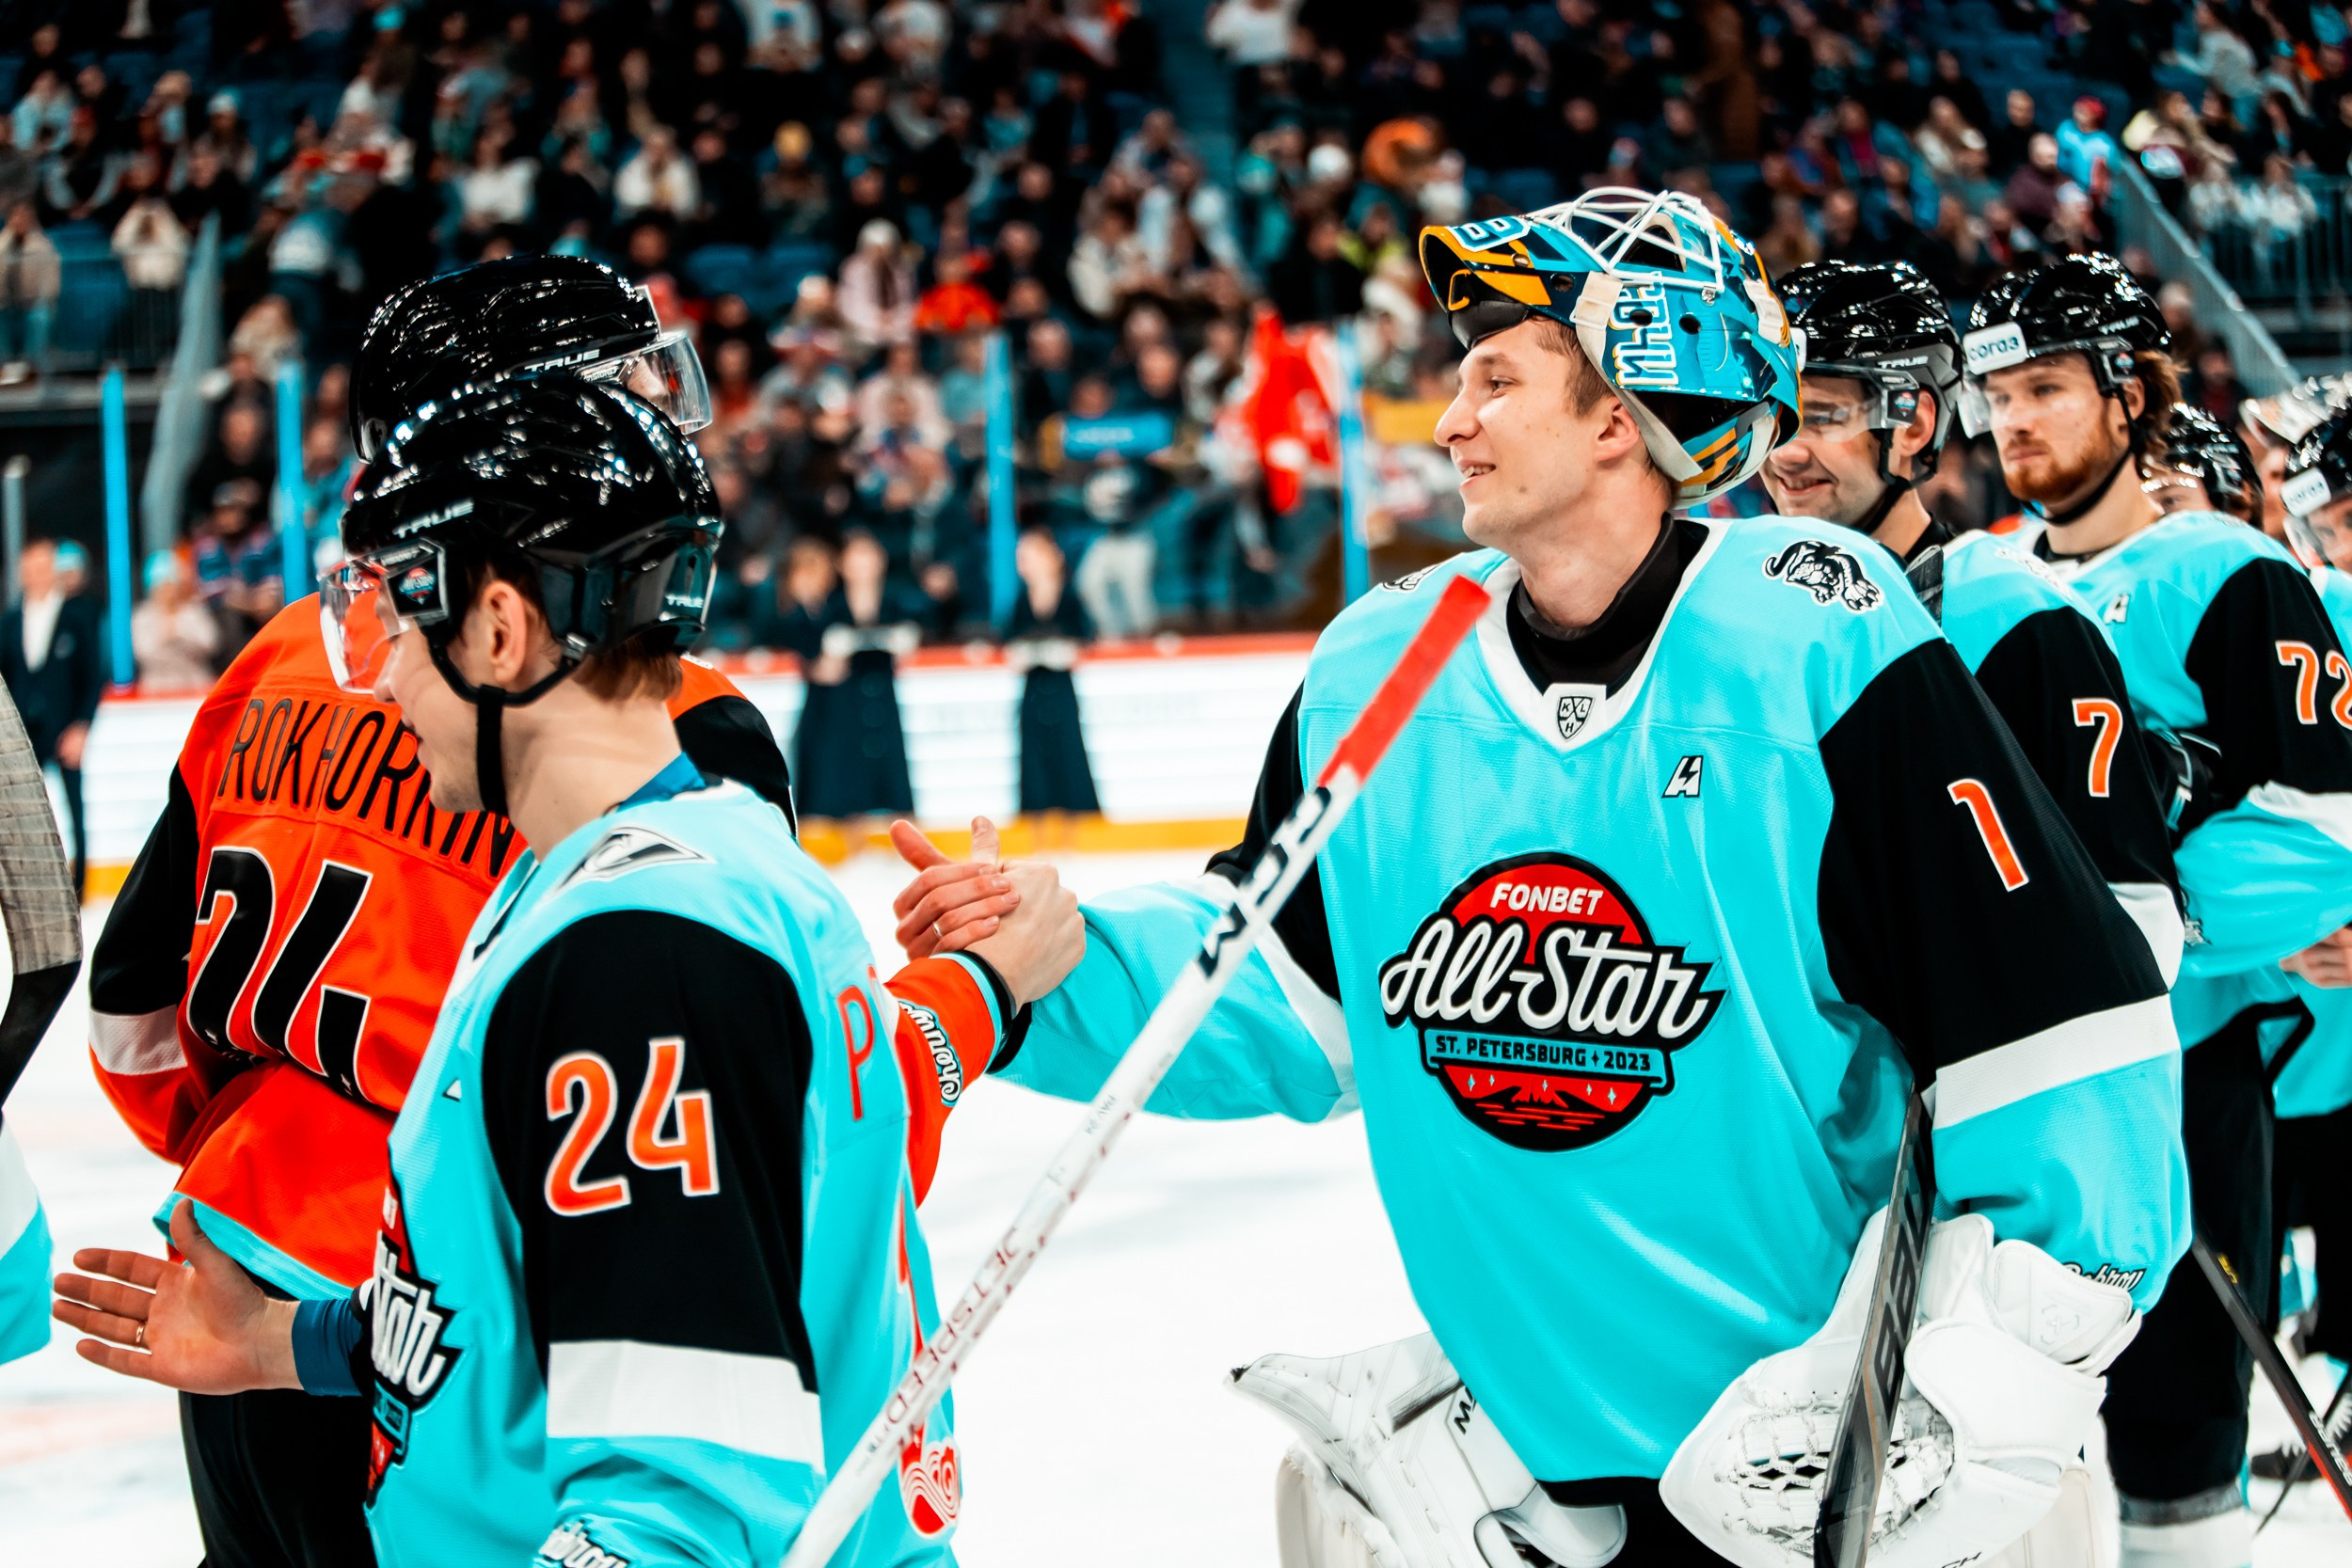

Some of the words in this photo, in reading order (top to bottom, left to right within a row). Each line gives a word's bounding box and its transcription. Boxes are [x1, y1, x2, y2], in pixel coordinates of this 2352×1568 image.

[524, 349, 600, 372] TRUE
[1877, 356, 1929, 369] TRUE
[391, 499, 473, 539] TRUE
[665, 594, 704, 609] TRUE
[2072, 697, 2123, 798] 7
[1947, 778, 2029, 892] 1
[1490, 882, 1603, 916] FONBET
[1380, 918, 1709, 1038] All-Star
[1435, 1036, 1460, 1054] ST.
[1467, 1038, 1586, 1068] PETERSBURG
[1603, 1052, 1651, 1071] 2023
[544, 1036, 721, 1217] 24
[883, 1227, 1014, 1427] JETSPEED
